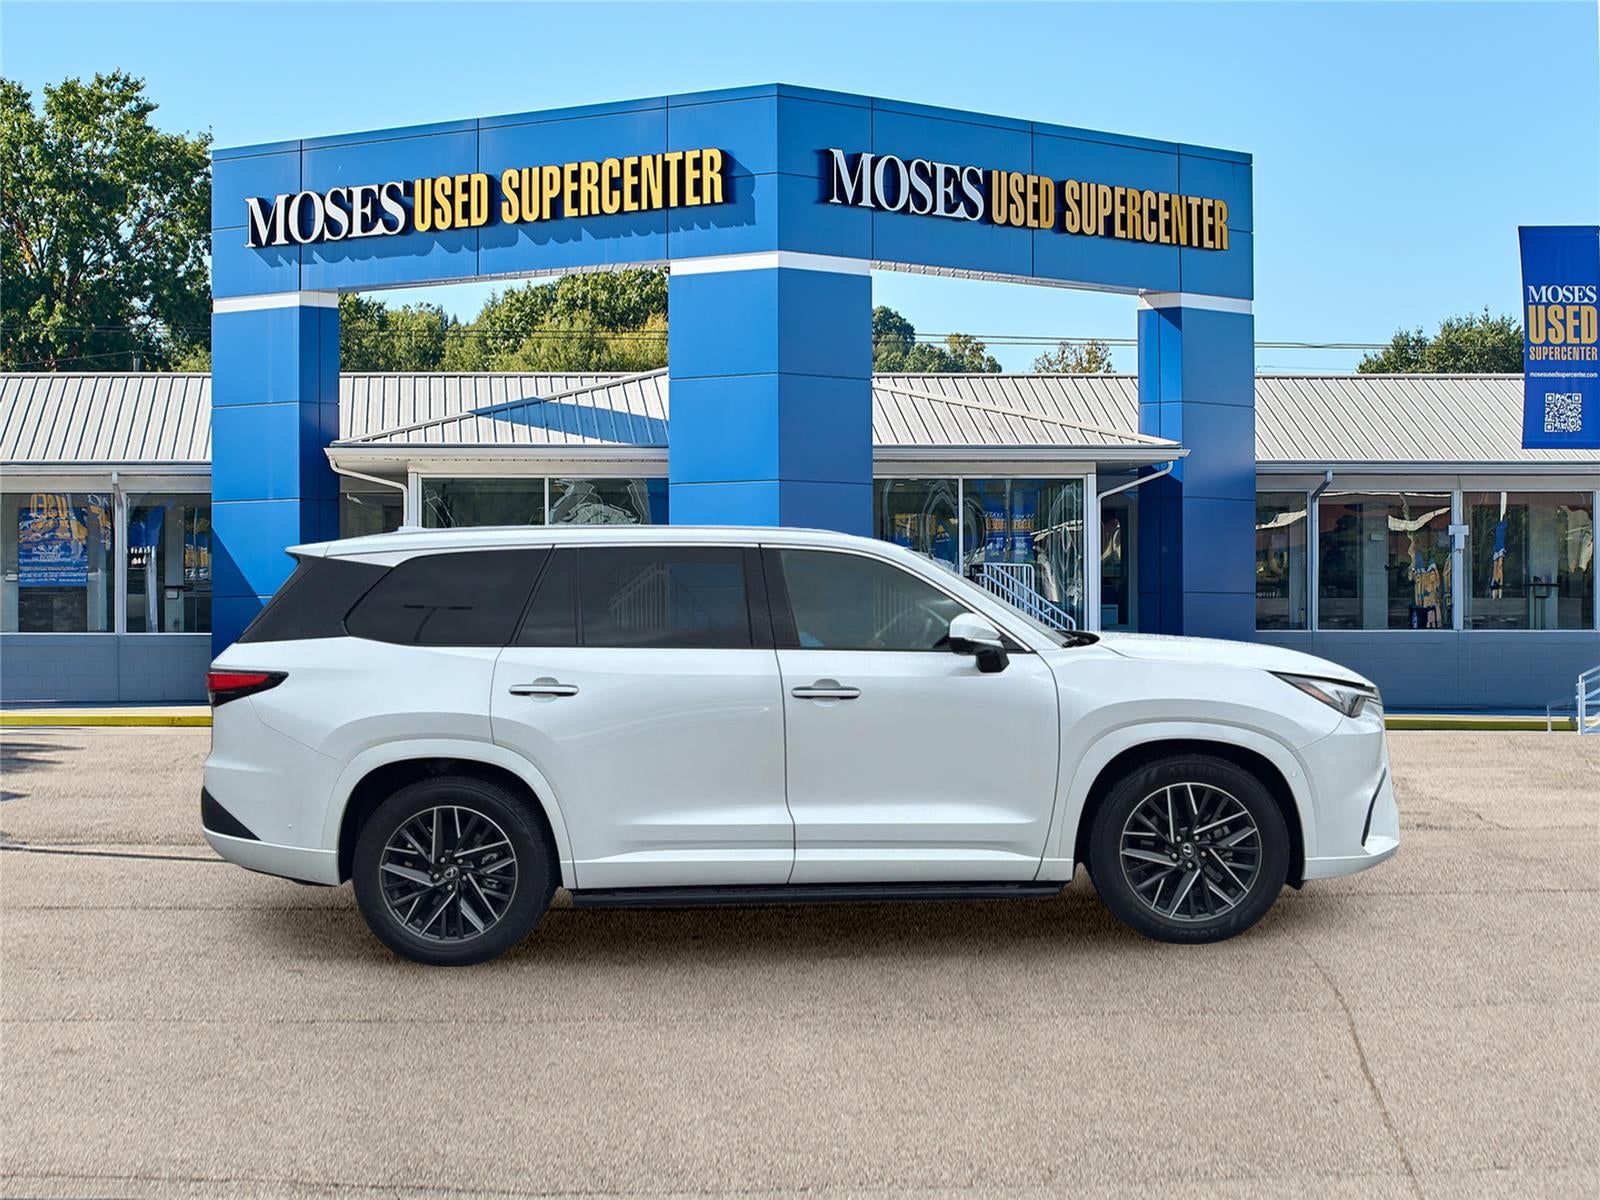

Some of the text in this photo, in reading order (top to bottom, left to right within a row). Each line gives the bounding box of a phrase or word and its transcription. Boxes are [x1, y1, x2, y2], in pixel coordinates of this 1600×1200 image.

[245, 148, 724, 248] MOSES USED SUPERCENTER
[829, 148, 1229, 250] MOSES USED SUPERCENTER
[1528, 285, 1597, 304] MOSES
[1528, 305, 1598, 344] USED
[1529, 346, 1598, 361] SUPERCENTER
